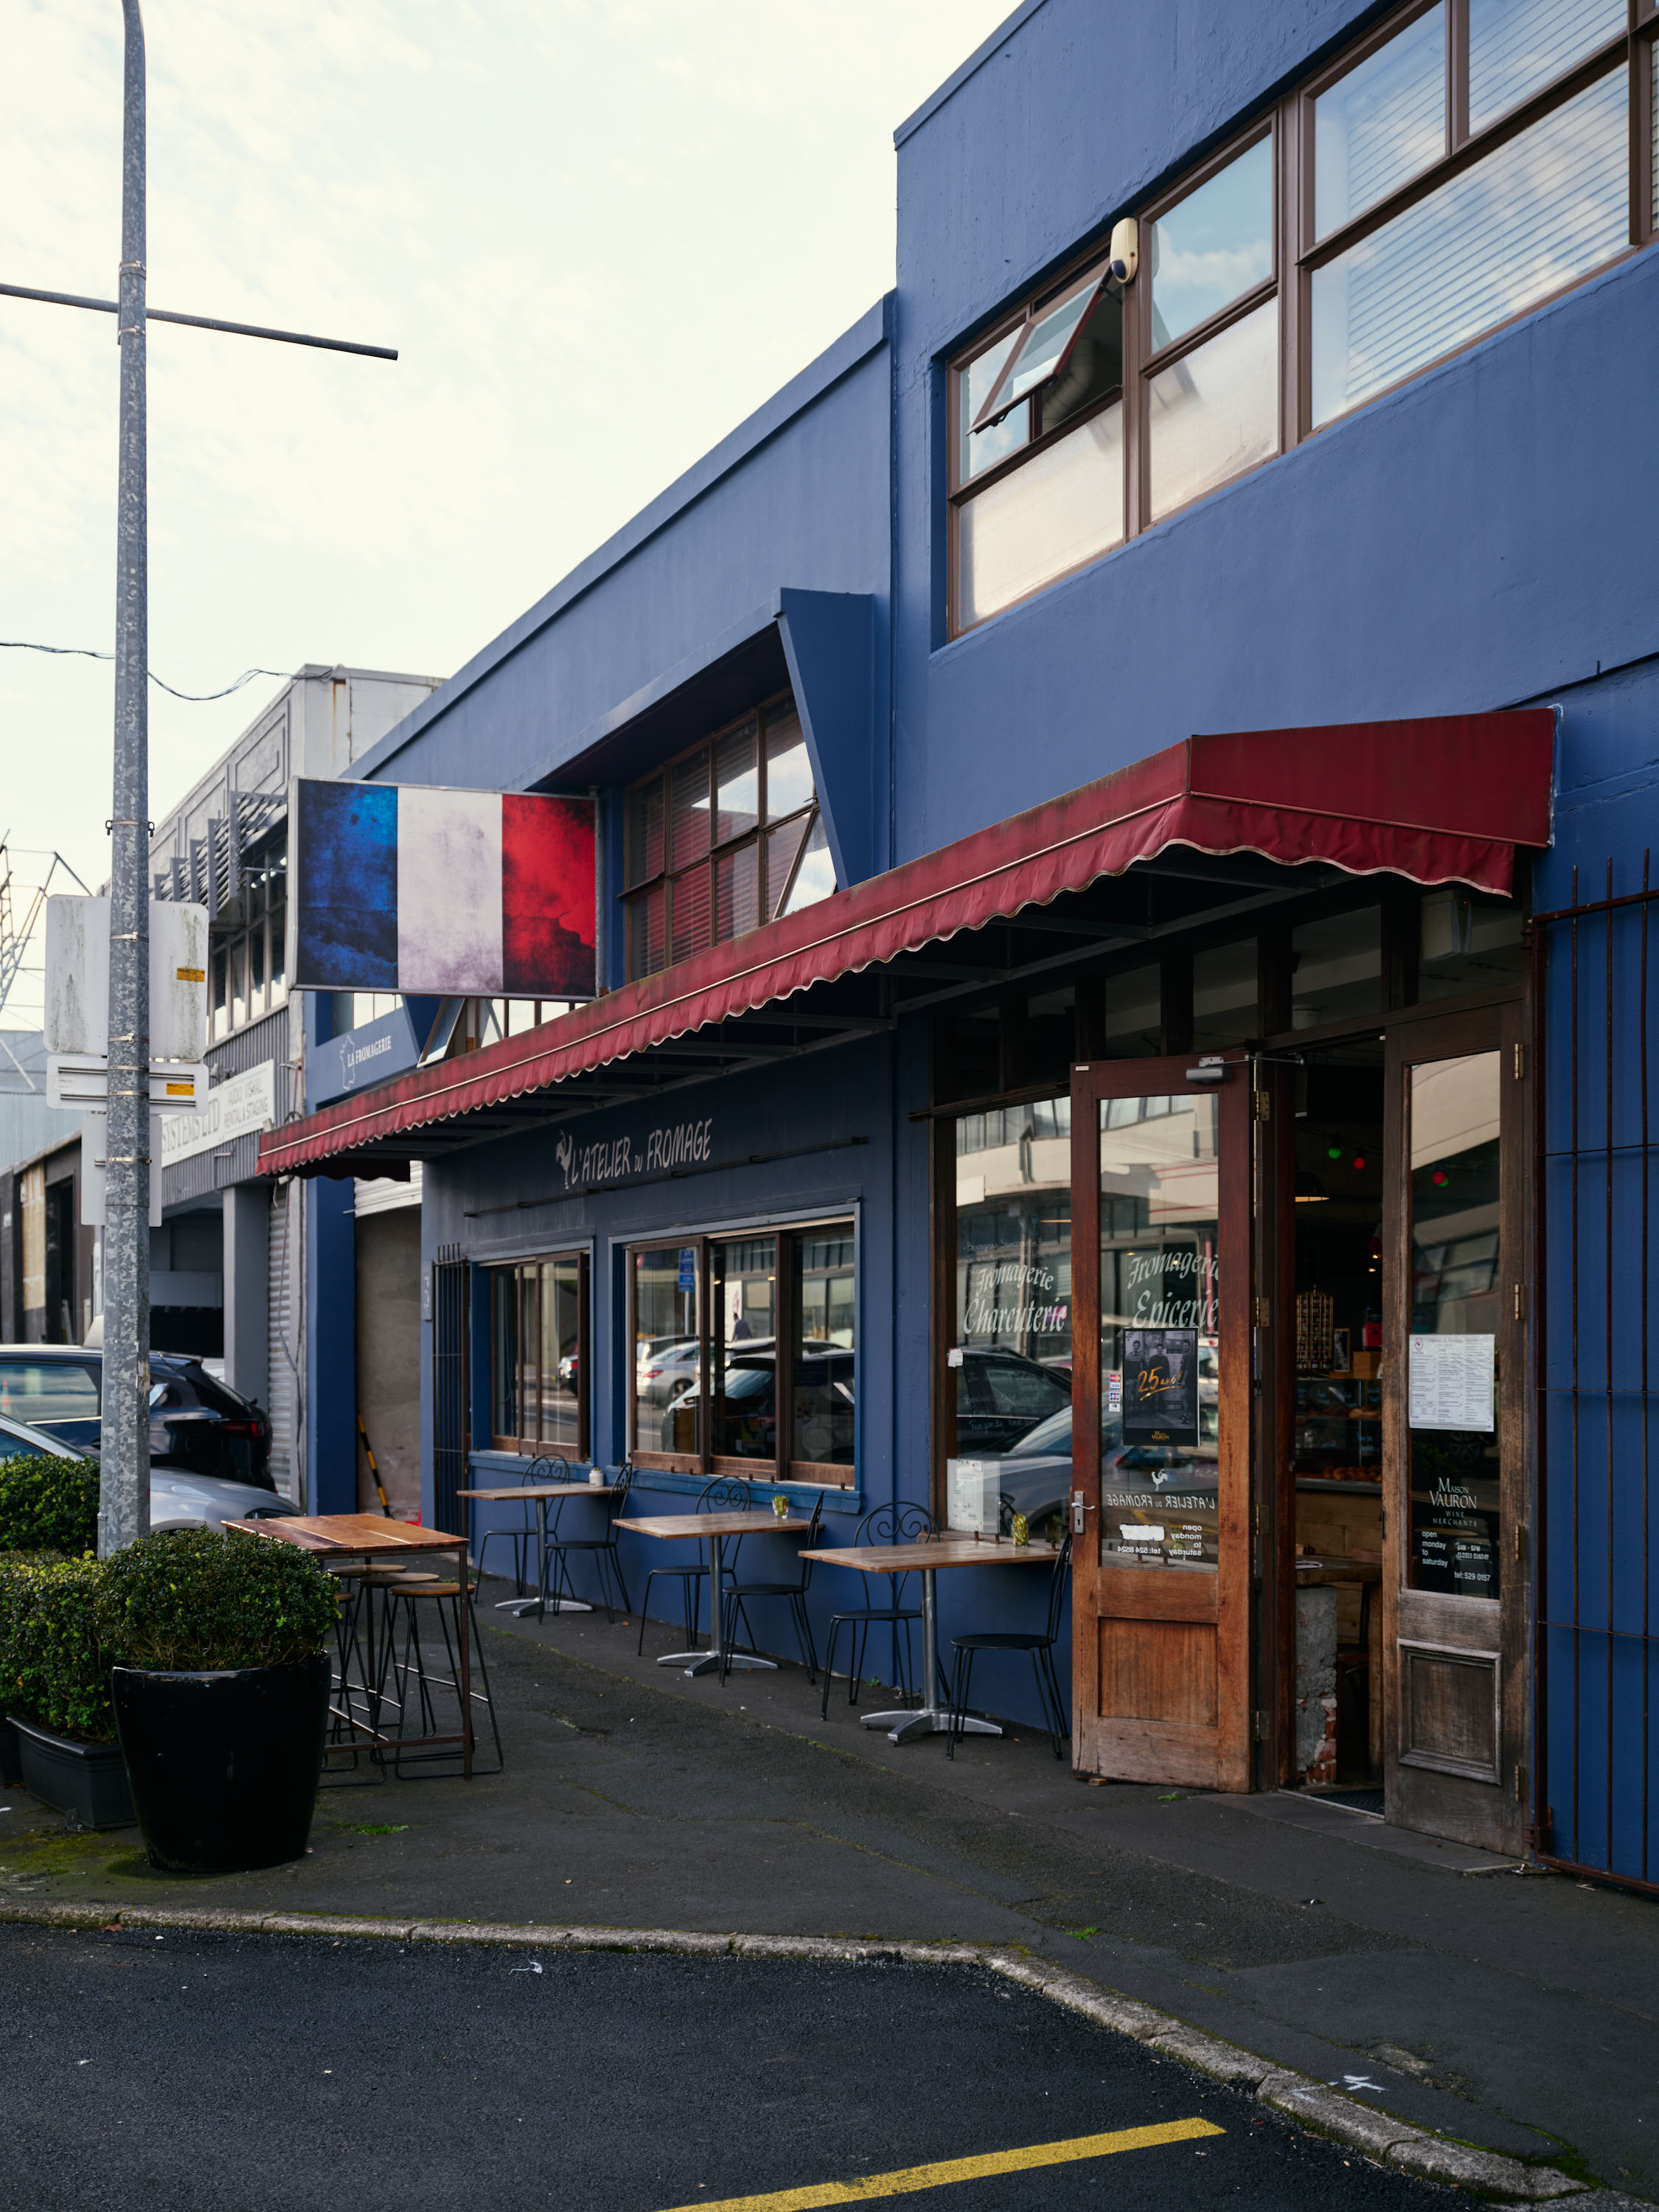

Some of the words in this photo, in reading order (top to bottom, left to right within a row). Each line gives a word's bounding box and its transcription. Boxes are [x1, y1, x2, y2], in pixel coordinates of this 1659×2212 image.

[347, 1054, 355, 1068] LA
[355, 1034, 392, 1065] FROMAGERIE
[571, 1136, 630, 1185] L'ATELIER
[634, 1154, 643, 1172] DU
[647, 1118, 712, 1172] FROMAGE
[975, 1264, 1054, 1298] Fromagerie
[963, 1296, 1068, 1335] Charcuterie
[1132, 1289, 1219, 1328] Epicerie
[1138, 1366, 1163, 1393] 25
[1429, 1490, 1477, 1509] VAURON
[1422, 1531, 1438, 1539] open
[1433, 1517, 1478, 1528] MERCHANTS
[1422, 1540, 1447, 1551] monday
[1422, 1557, 1448, 1568] saturday
